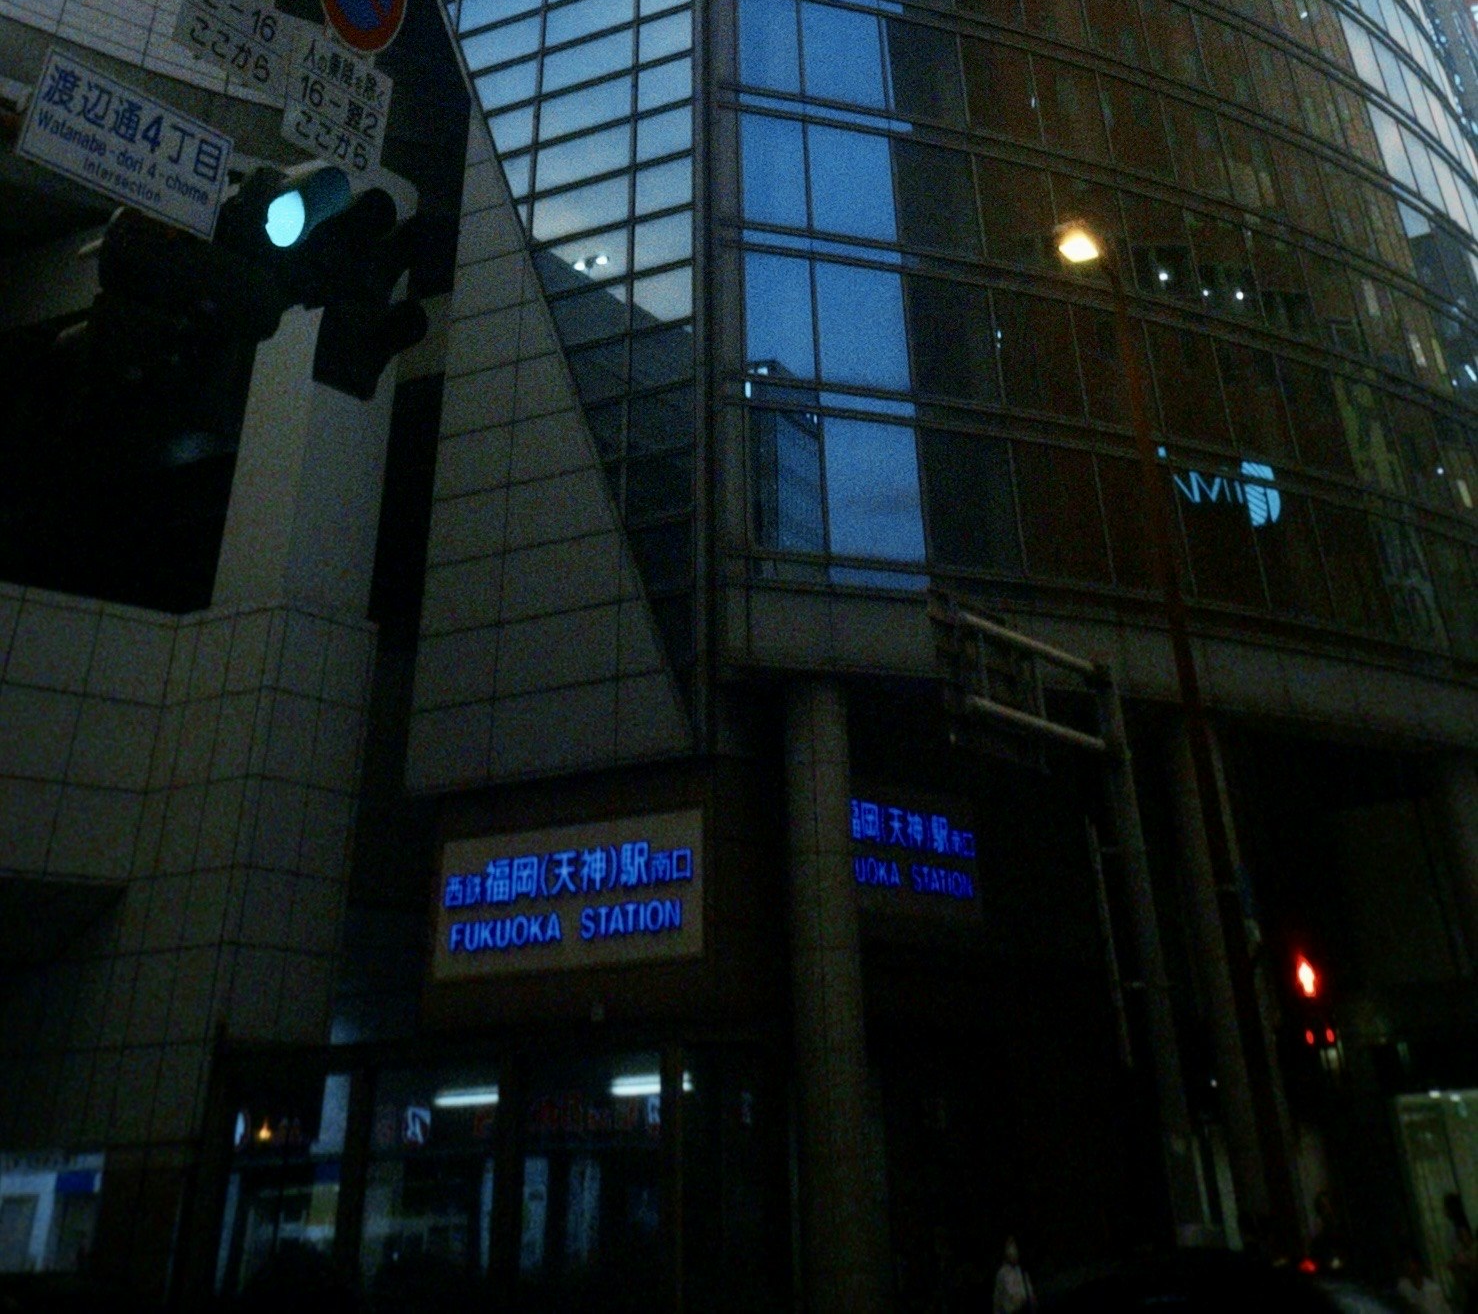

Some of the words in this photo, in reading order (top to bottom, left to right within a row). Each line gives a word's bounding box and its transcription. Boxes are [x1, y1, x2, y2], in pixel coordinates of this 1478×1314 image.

[190, 16, 270, 83] ここから
[42, 65, 223, 182] 渡辺通4丁目
[295, 110, 368, 172] ここから
[853, 855, 901, 887] UOKA
[910, 863, 974, 900] STATION
[449, 911, 562, 953] FUKUOKA
[580, 898, 682, 941] STATION
